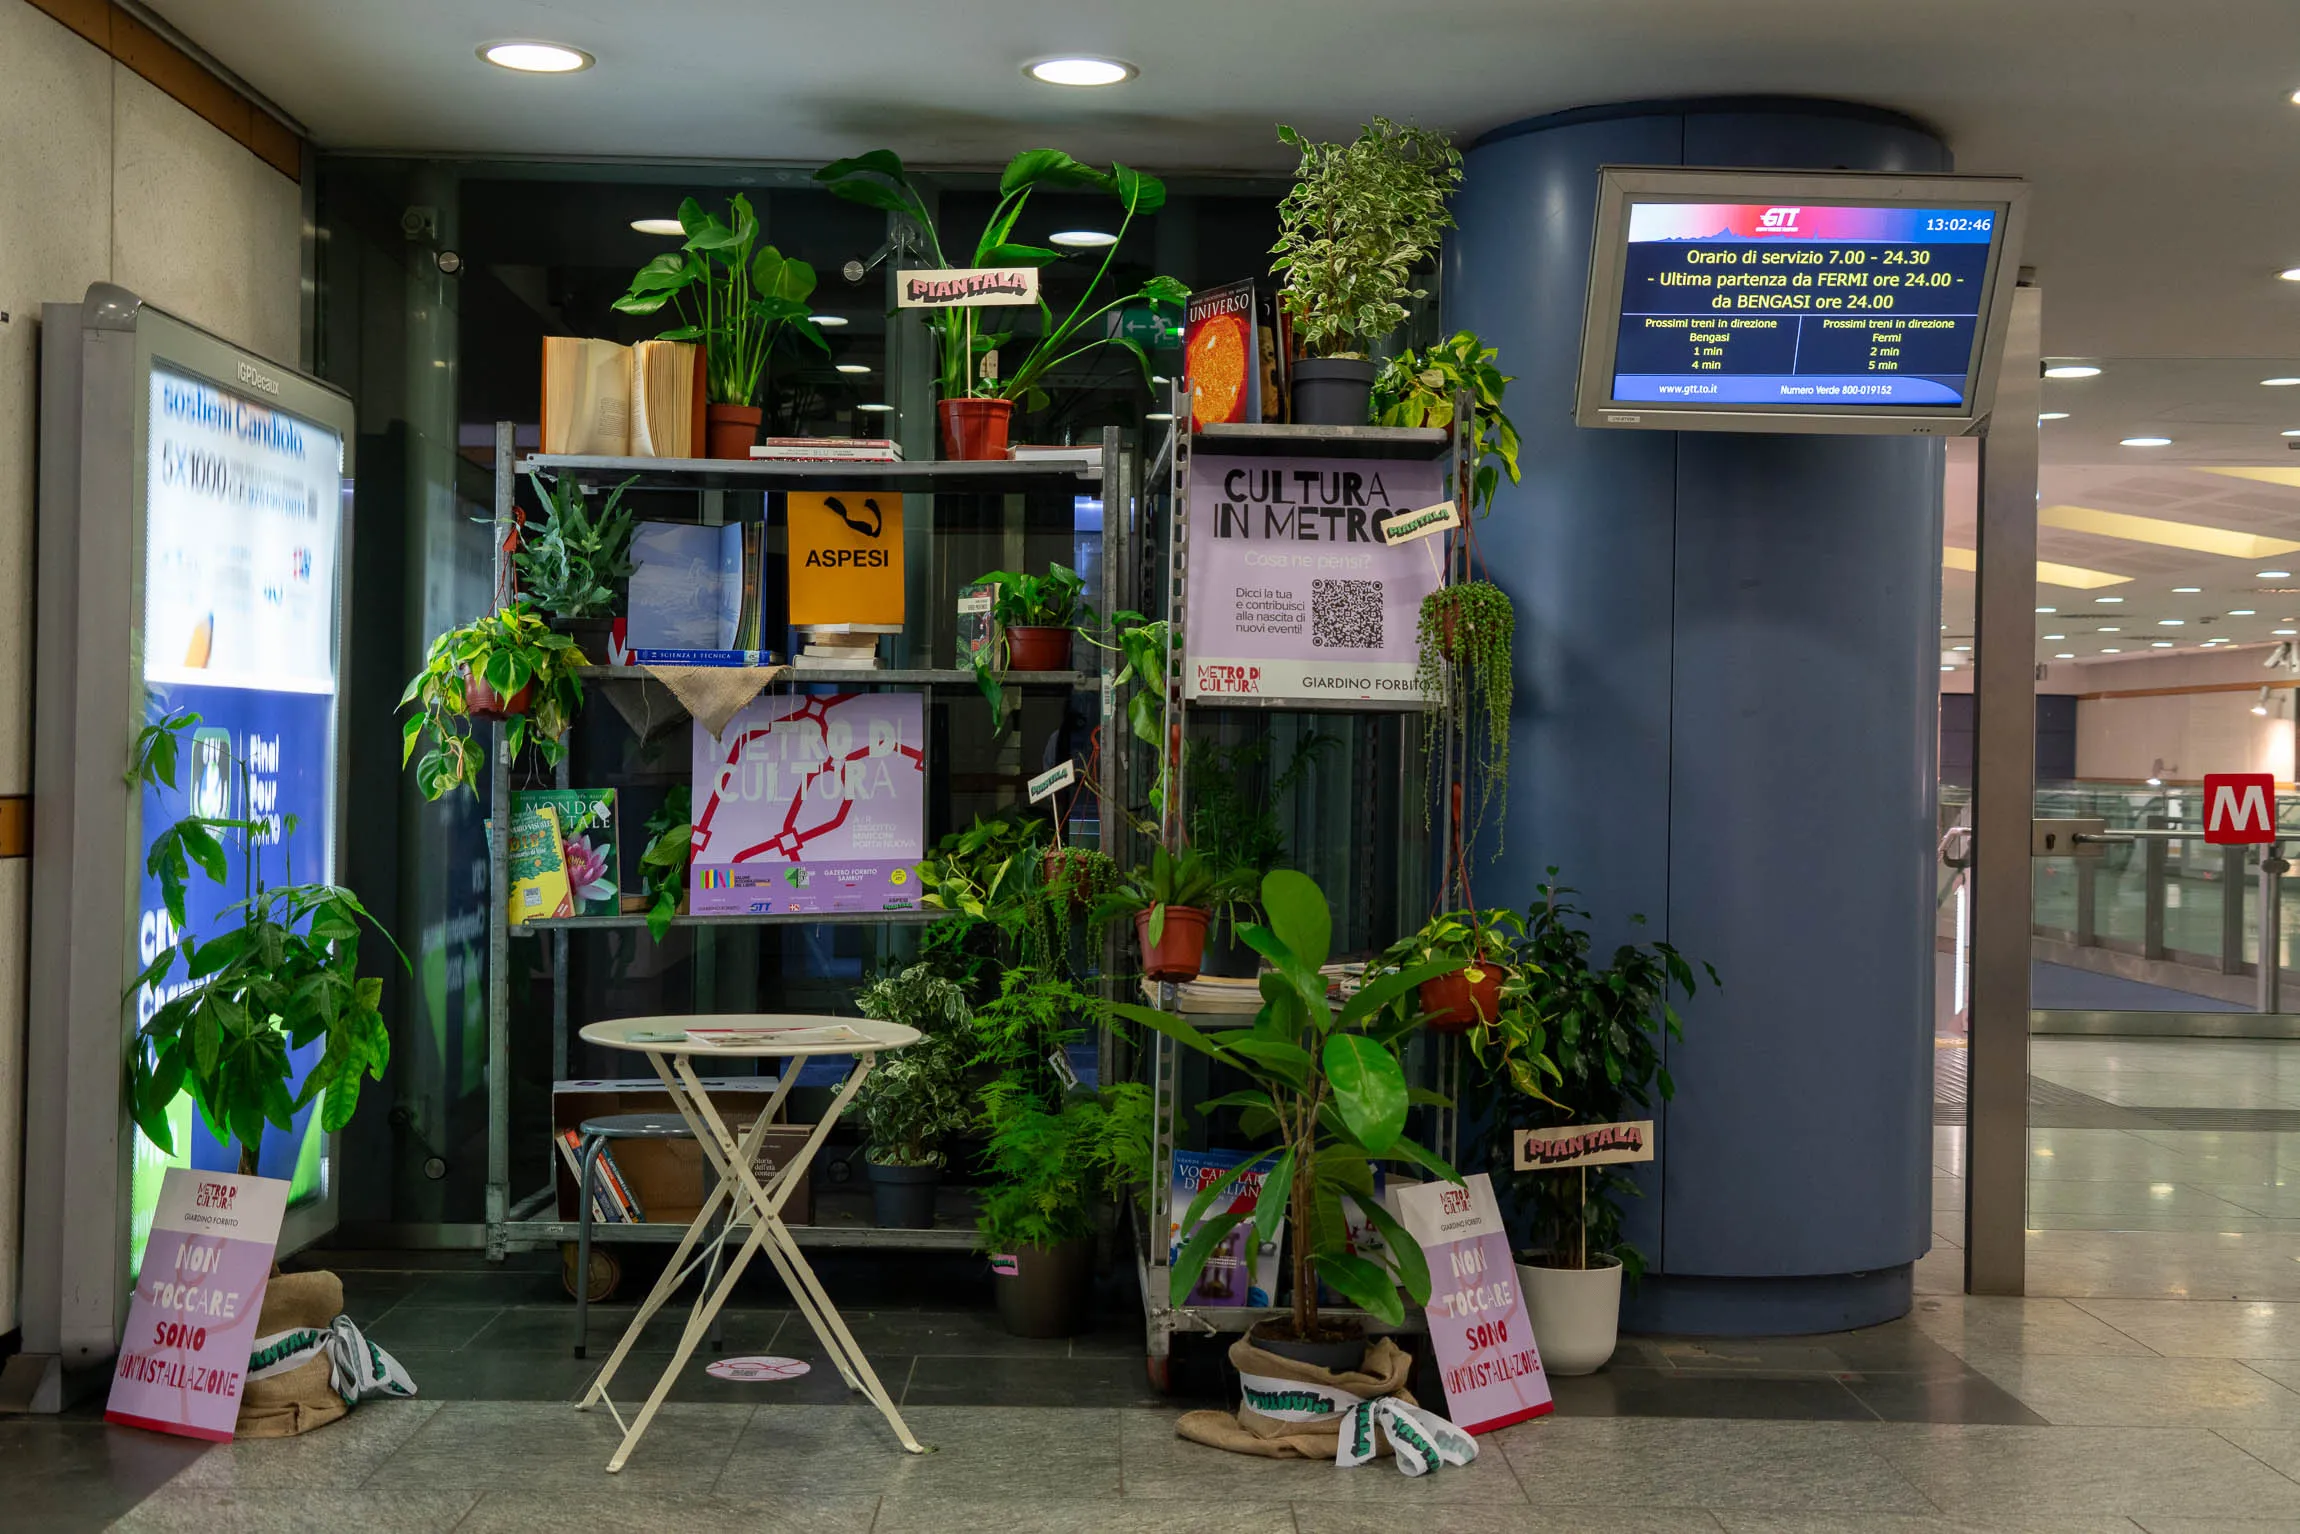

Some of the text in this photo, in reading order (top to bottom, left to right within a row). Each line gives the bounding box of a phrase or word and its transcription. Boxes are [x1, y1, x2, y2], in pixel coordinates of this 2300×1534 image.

[1760, 208, 1800, 227] GTT
[1926, 219, 1991, 231] 13:02:46
[1687, 250, 1737, 264] Orario
[1742, 250, 1757, 264] di
[1762, 250, 1824, 264] servizio
[1829, 251, 1865, 264] 7.00
[1883, 251, 1930, 264] 24.30
[907, 272, 1028, 303] PIANTALA
[1660, 272, 1712, 286] Ultima
[1716, 273, 1787, 289] partenza
[1792, 272, 1811, 286] da
[1818, 273, 1869, 287] FERMI
[1873, 276, 1900, 287] ore
[1904, 273, 1951, 287] 24.00
[1190, 293, 1249, 322] UNIVERSO
[1712, 295, 1894, 309] da BENGASI ore 24.00
[1645, 319, 1777, 328] Prossimi treni in direzione
[1823, 319, 1955, 329] Prossimi treni in direzione
[1689, 333, 1730, 343] Bengasi
[1872, 333, 1901, 342] Fermi
[1693, 347, 1723, 356] 1 min
[1870, 347, 1899, 356] 2 min
[1691, 361, 1721, 370] 4 min
[1868, 361, 1897, 370] 5 min
[237, 360, 280, 395] IGPDecaux
[1659, 385, 1718, 395] www.gtt.to.it
[1780, 386, 1892, 395] Numero Verde 800-019152
[1223, 469, 1391, 506] CULTURA
[1214, 503, 1412, 543] IN METRO
[1387, 508, 1450, 538] PIANTALA
[805, 549, 889, 568] ASPESI
[1244, 551, 1372, 571] Cosa ne pensi?
[1235, 588, 1293, 599] Dicci la tua
[1236, 601, 1306, 611] e contribuisci
[1235, 612, 1306, 623] alla nascita di
[1235, 624, 1303, 634] nuovi eventi!
[1197, 665, 1261, 680] METRO DI
[1200, 678, 1259, 693] CULTURA
[1302, 676, 1372, 690] GIARDINO
[869, 717, 904, 758] DI
[250, 733, 280, 773] Final
[713, 760, 898, 804] CULTURA
[249, 773, 277, 812] Four
[2208, 785, 2271, 831] M
[1524, 1127, 1643, 1165] PIANTALA
[197, 1182, 228, 1197] METRO
[1184, 1178, 1200, 1190] DI
[196, 1194, 233, 1210] CULTURA
[184, 1213, 239, 1227] GIARDINO FORBITO
[175, 1243, 222, 1274] NON
[1450, 1246, 1488, 1278] NON
[152, 1280, 239, 1319] TOCCARE
[1442, 1280, 1513, 1319] TOCCARE
[153, 1321, 207, 1352] SONO
[1466, 1319, 1508, 1351] SONO
[118, 1353, 239, 1397] UN'INSTALLAZIONE
[1447, 1349, 1540, 1394] UN'INSTALLAZIONE
